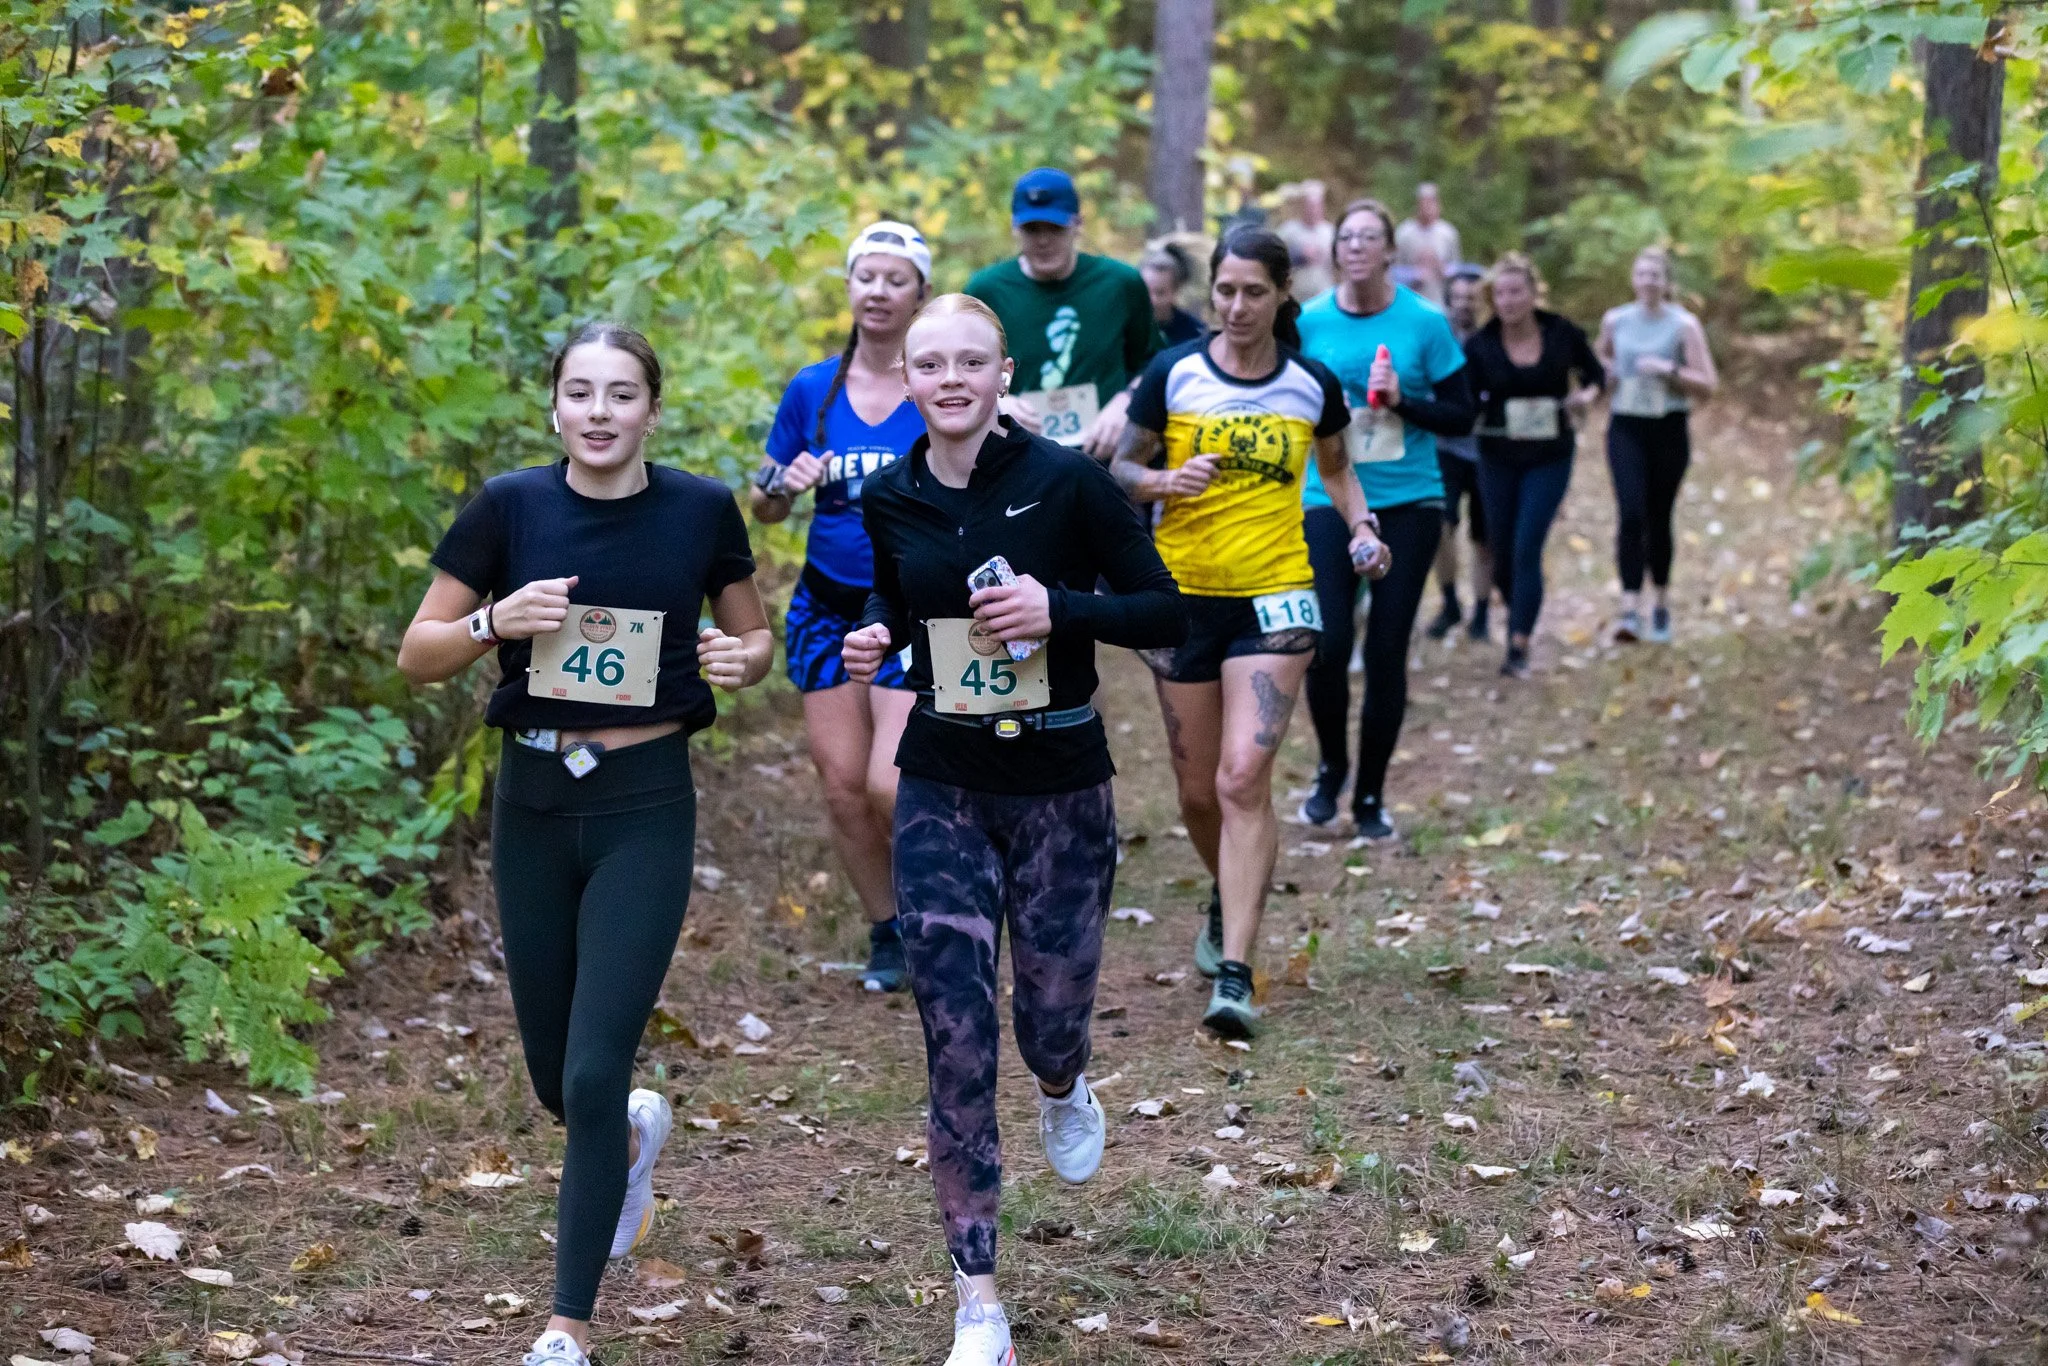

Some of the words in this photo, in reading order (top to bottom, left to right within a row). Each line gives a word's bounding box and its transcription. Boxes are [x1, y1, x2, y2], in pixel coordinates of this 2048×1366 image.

[1043, 411, 1081, 437] 23
[1257, 598, 1314, 627] 118
[629, 621, 644, 634] 7K
[561, 645, 626, 687] 46
[960, 659, 1017, 696] 45
